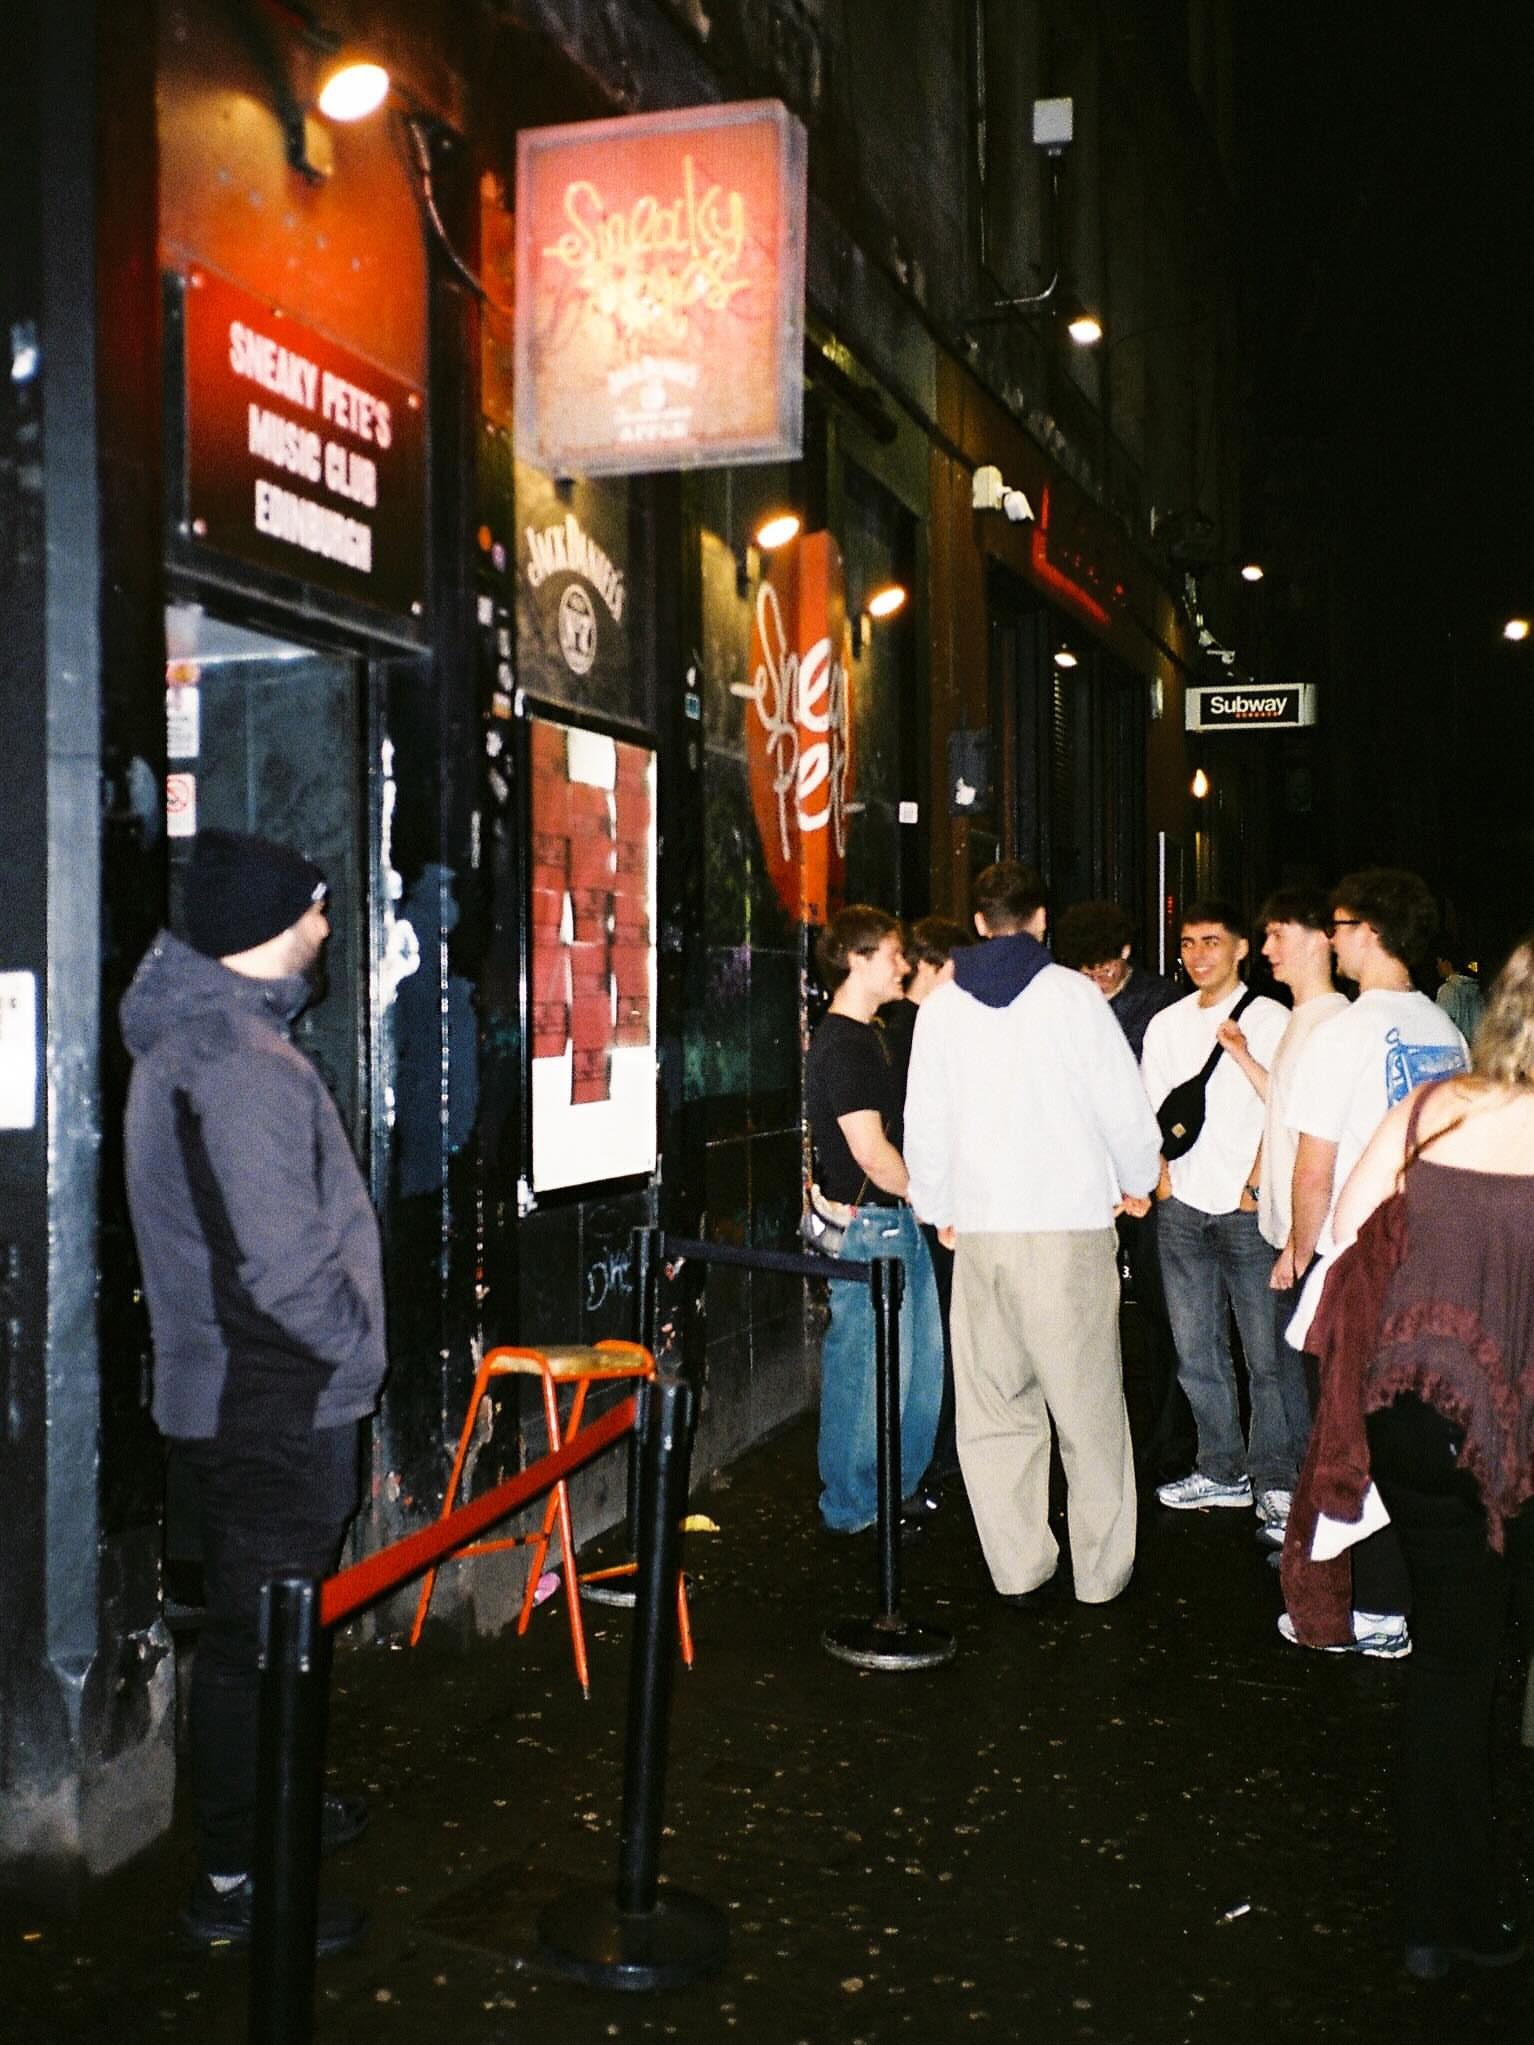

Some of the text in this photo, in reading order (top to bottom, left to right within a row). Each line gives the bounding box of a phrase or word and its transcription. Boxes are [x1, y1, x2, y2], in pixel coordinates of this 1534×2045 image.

[229, 320, 393, 449] SNEAKY PETE'S
[248, 403, 377, 508] MUSIC CLUB
[1210, 696, 1288, 715] Subway
